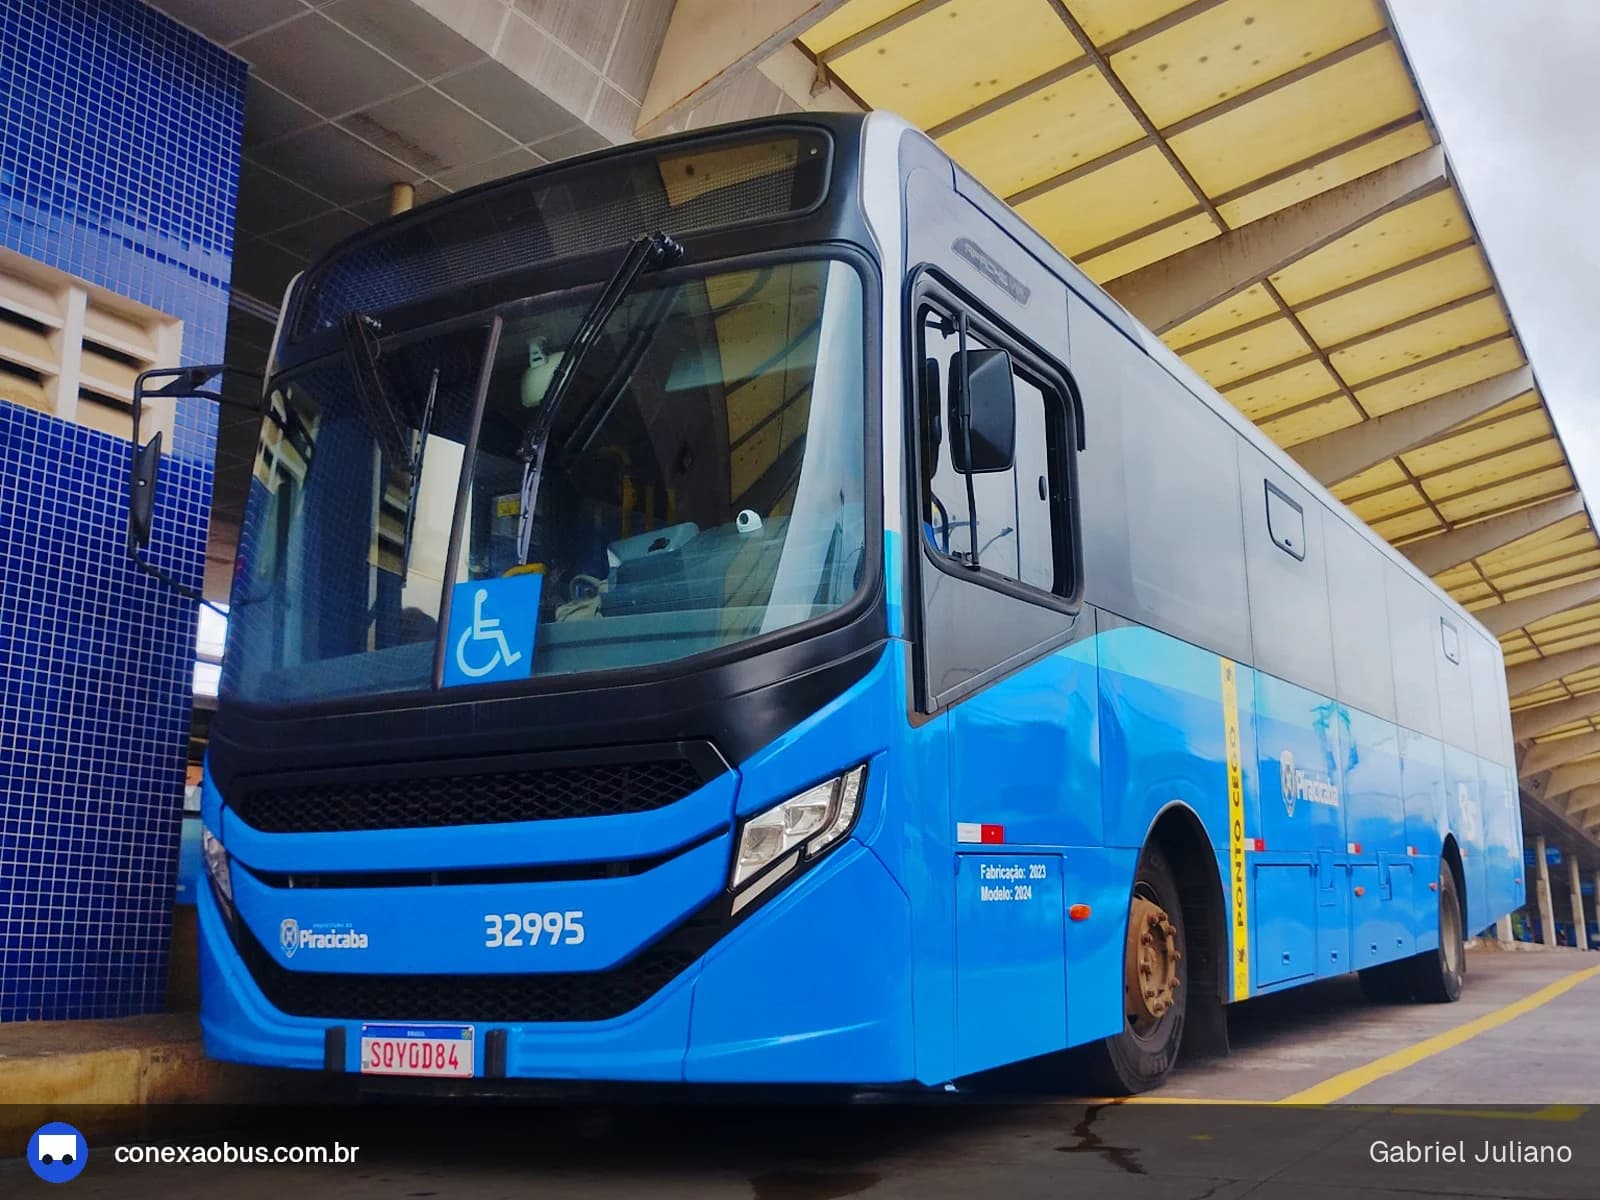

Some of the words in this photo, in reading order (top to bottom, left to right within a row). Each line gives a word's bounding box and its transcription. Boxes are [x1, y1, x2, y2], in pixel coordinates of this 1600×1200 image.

[981, 864, 1026, 883] Fabricação:
[1029, 864, 1047, 879] 2023
[1233, 819, 1244, 927] PONTO
[981, 885, 1013, 901] Modelo:
[1014, 885, 1032, 901] 2024
[300, 928, 369, 949] Piracicaba
[484, 911, 585, 948] 32995
